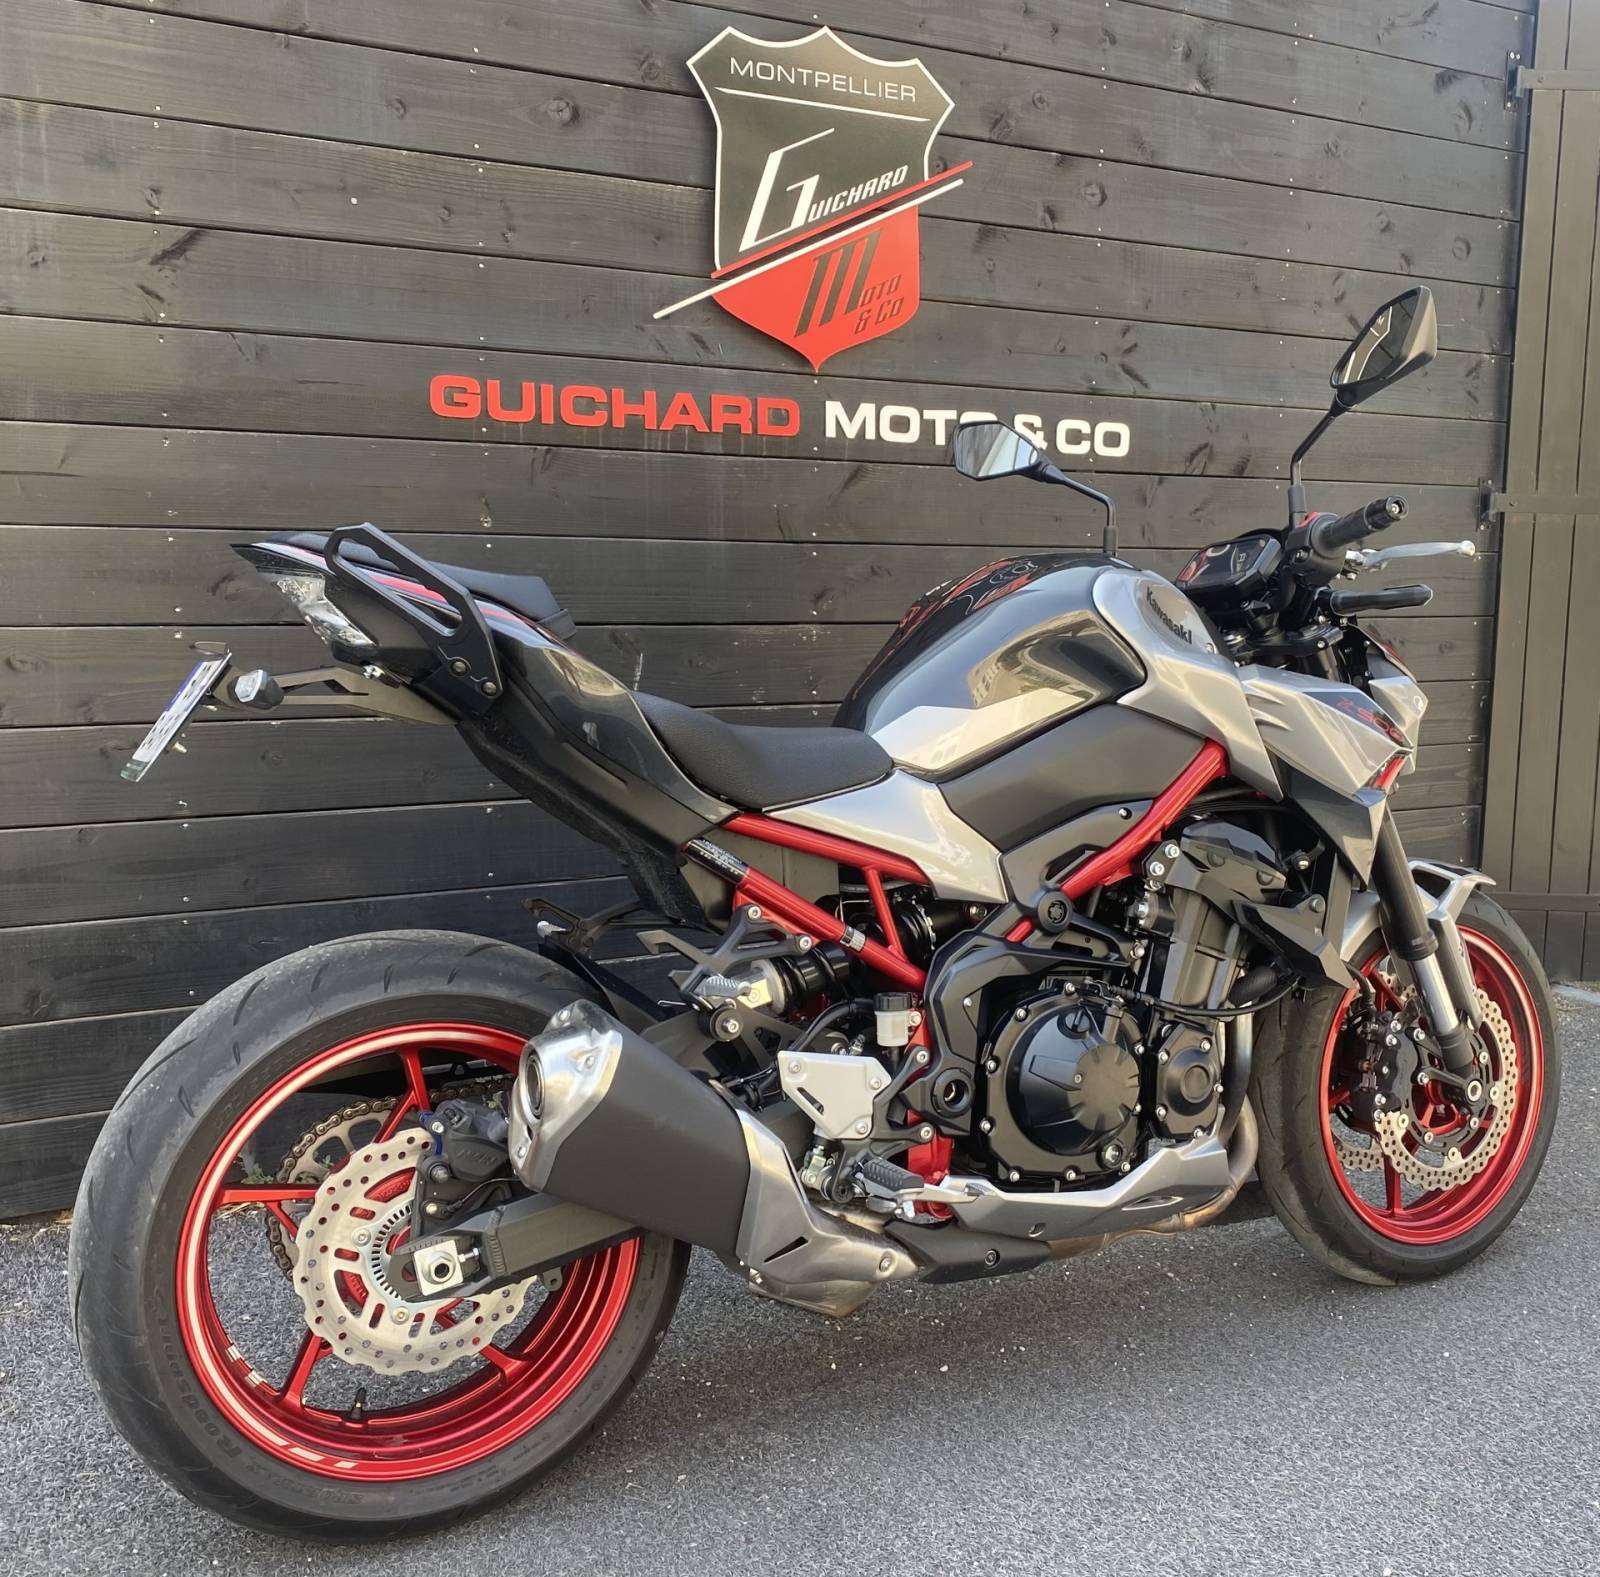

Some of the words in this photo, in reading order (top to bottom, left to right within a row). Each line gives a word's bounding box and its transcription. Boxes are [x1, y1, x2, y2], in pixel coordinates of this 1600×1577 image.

[731, 57, 916, 103] MONTPELLIER
[738, 127, 909, 252] GUICHARD
[429, 375, 801, 437] GUICHARD
[1056, 419, 1130, 457] CO
[1146, 586, 1193, 645] Kawasaki
